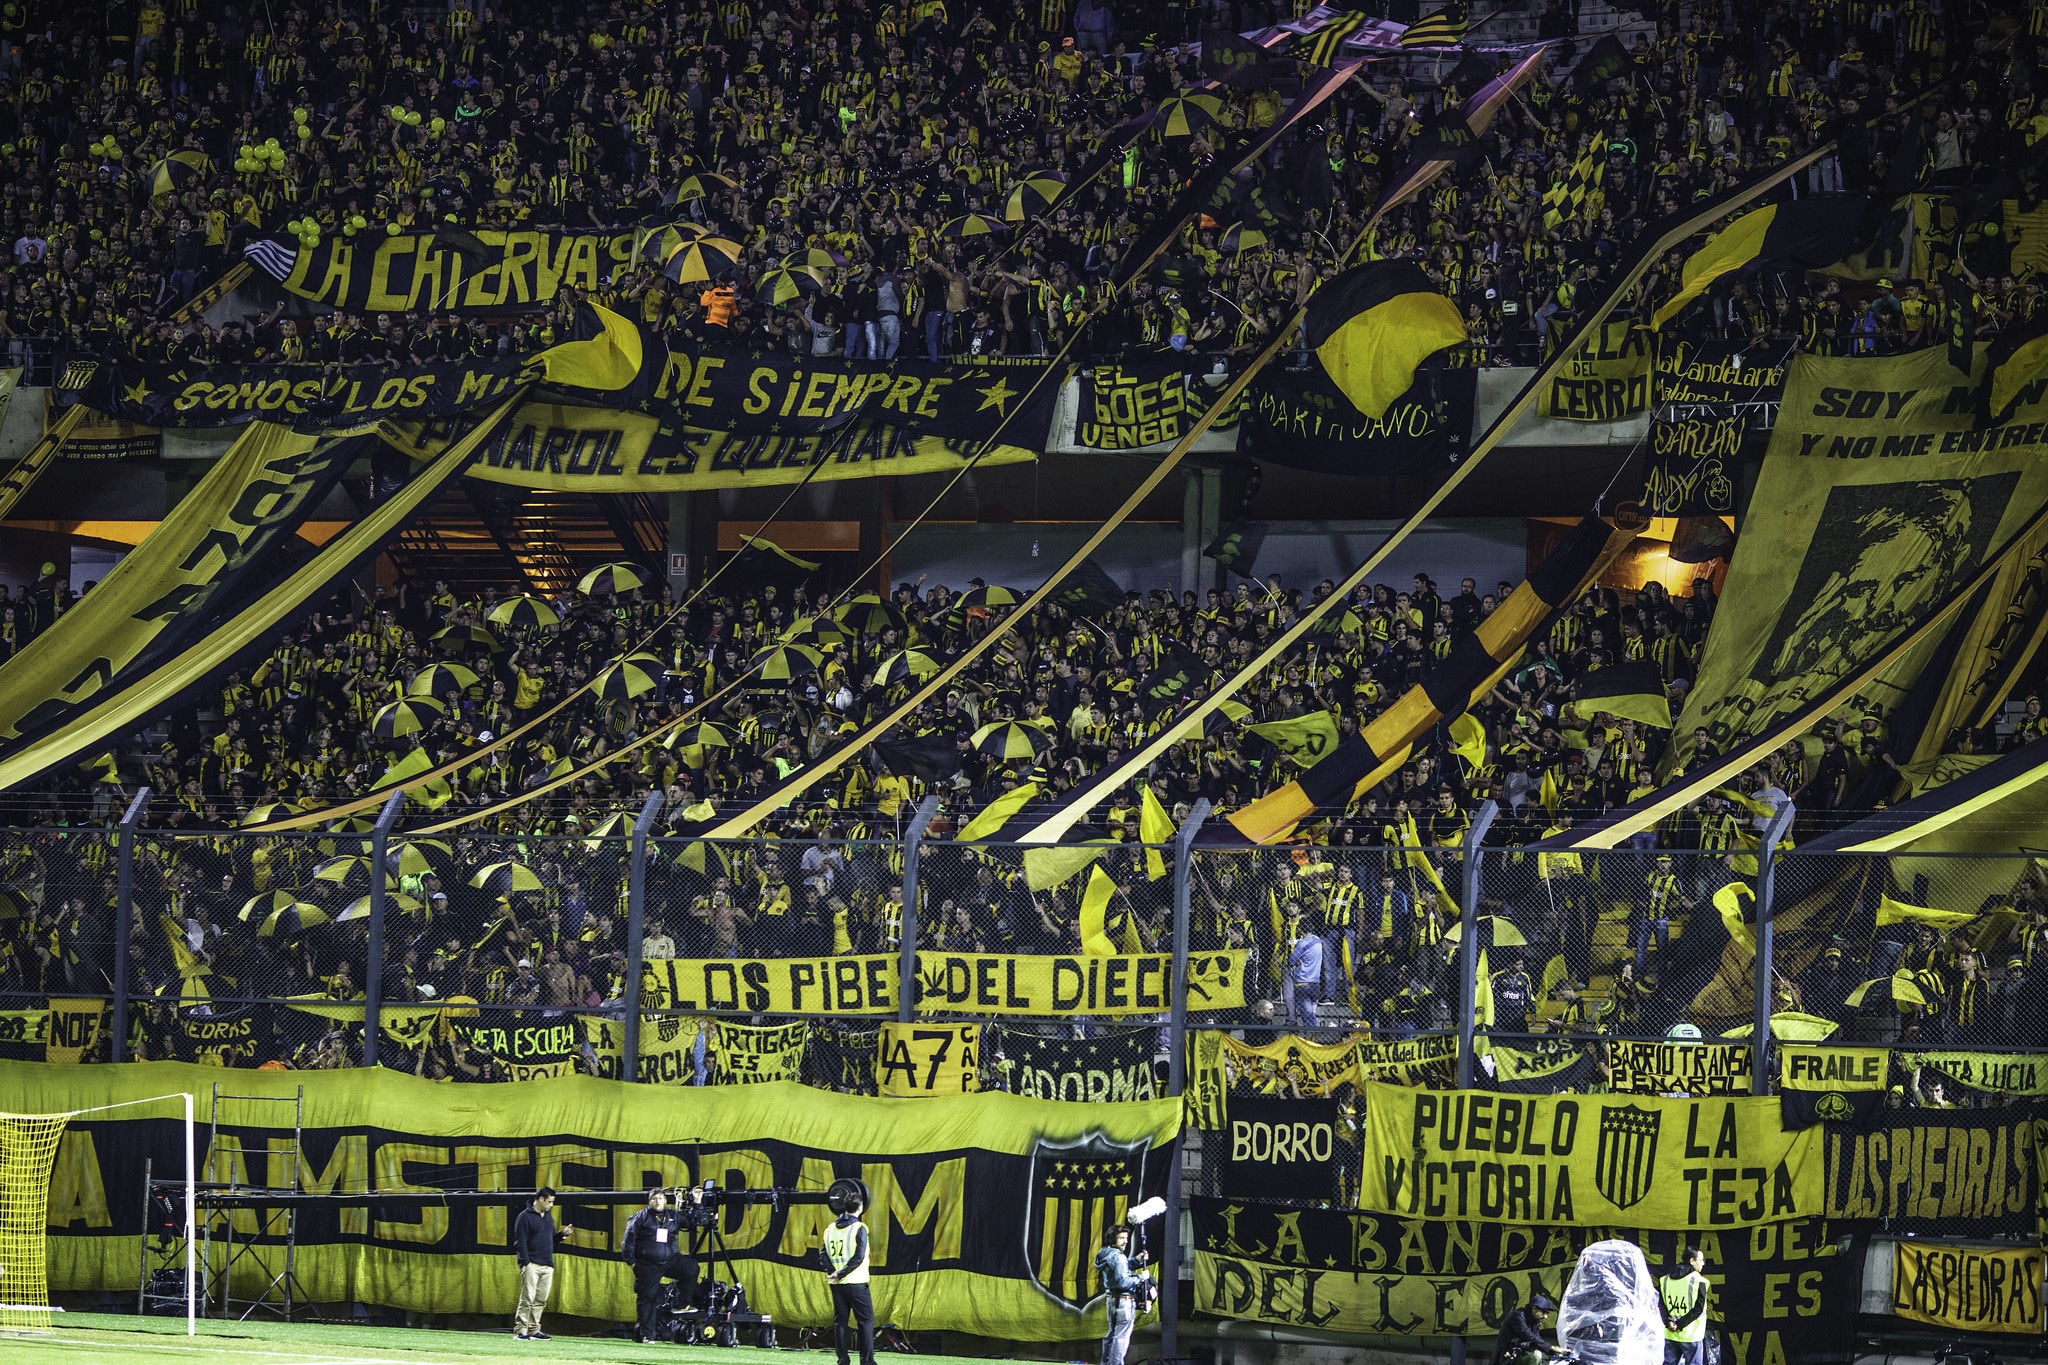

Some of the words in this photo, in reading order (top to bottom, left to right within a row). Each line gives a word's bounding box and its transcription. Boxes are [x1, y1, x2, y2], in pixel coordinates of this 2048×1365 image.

[282, 236, 354, 307] LA
[339, 374, 436, 414] LOS
[655, 350, 726, 407] DE
[1574, 362, 1598, 376] DEL
[1550, 373, 1648, 418] CERRO
[1812, 386, 1920, 420] SOY
[638, 430, 708, 472] ES
[1800, 434, 1825, 456] Y
[1827, 436, 1878, 459] NO
[1880, 434, 1935, 458] ME
[667, 958, 771, 1013] LOS
[945, 956, 1030, 1009] DEL
[581, 1021, 615, 1050] LA
[1536, 1037, 1574, 1055] LOS
[730, 1053, 760, 1072] ES
[1608, 1039, 1676, 1076] BARRIO
[1791, 1054, 1880, 1082] FRAILE
[1981, 1062, 2036, 1091] LUCIA
[1232, 1120, 1334, 1165] BORRO
[1413, 1092, 1580, 1157] PUEBLO
[1684, 1103, 1738, 1159] LA
[202, 1133, 968, 1268] AMSTERDAM
[1384, 1155, 1575, 1221] VICTORIA
[1683, 1167, 1797, 1227] TEJA
[1218, 1203, 1312, 1266] LA
[1346, 1213, 1585, 1276] BANDA
[1749, 1220, 1838, 1261] DEL
[1212, 1257, 1341, 1329] DEL
[1667, 1295, 1688, 1314] 344
[1762, 1269, 1823, 1319] ES
